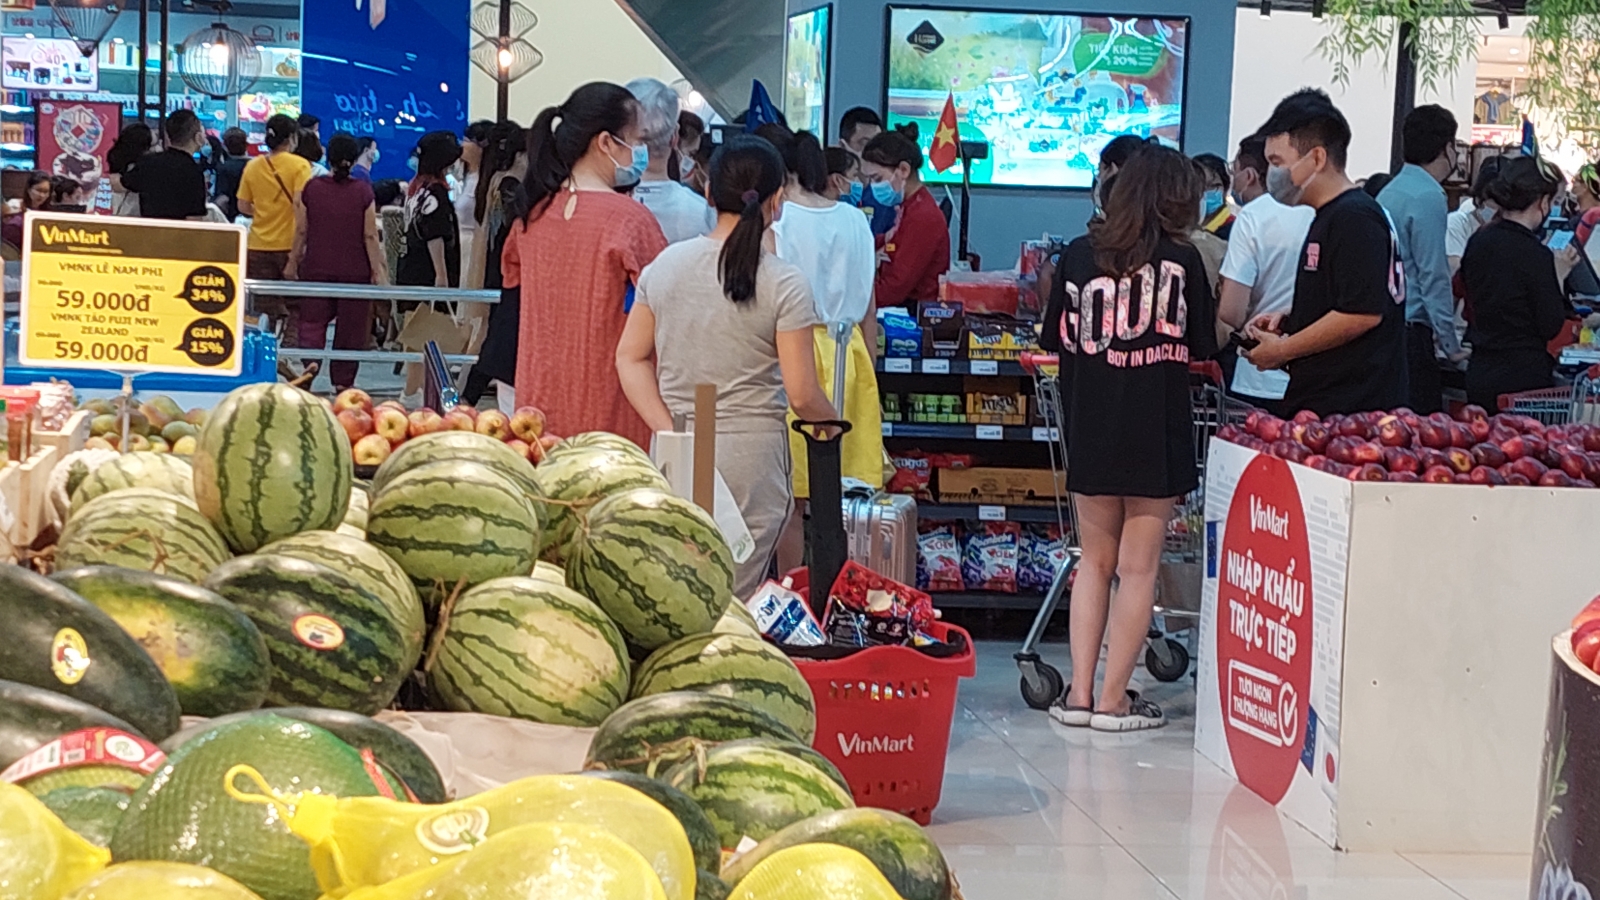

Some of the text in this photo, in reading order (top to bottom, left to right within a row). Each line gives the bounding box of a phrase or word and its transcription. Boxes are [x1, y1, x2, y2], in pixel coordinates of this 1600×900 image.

[39, 224, 110, 245] VinMart
[112, 265, 139, 276] NAM
[141, 267, 163, 277] PHI
[56, 290, 151, 312] 59.000đ
[190, 288, 226, 303] 34%
[1060, 260, 1188, 355] GOOD
[80, 325, 129, 336] ZEALAND
[109, 315, 132, 325] FUJI
[134, 317, 159, 327] NEW
[55, 341, 149, 363] 59.000đ
[190, 341, 225, 355] 15%
[1107, 348, 1128, 368] BOY
[1131, 349, 1144, 367] IN
[1250, 493, 1289, 540] VinMart
[1227, 548, 1305, 617] NHẬP KHẨU
[1229, 598, 1297, 665] TRỰC TIẾP
[836, 732, 915, 758] VinMart
